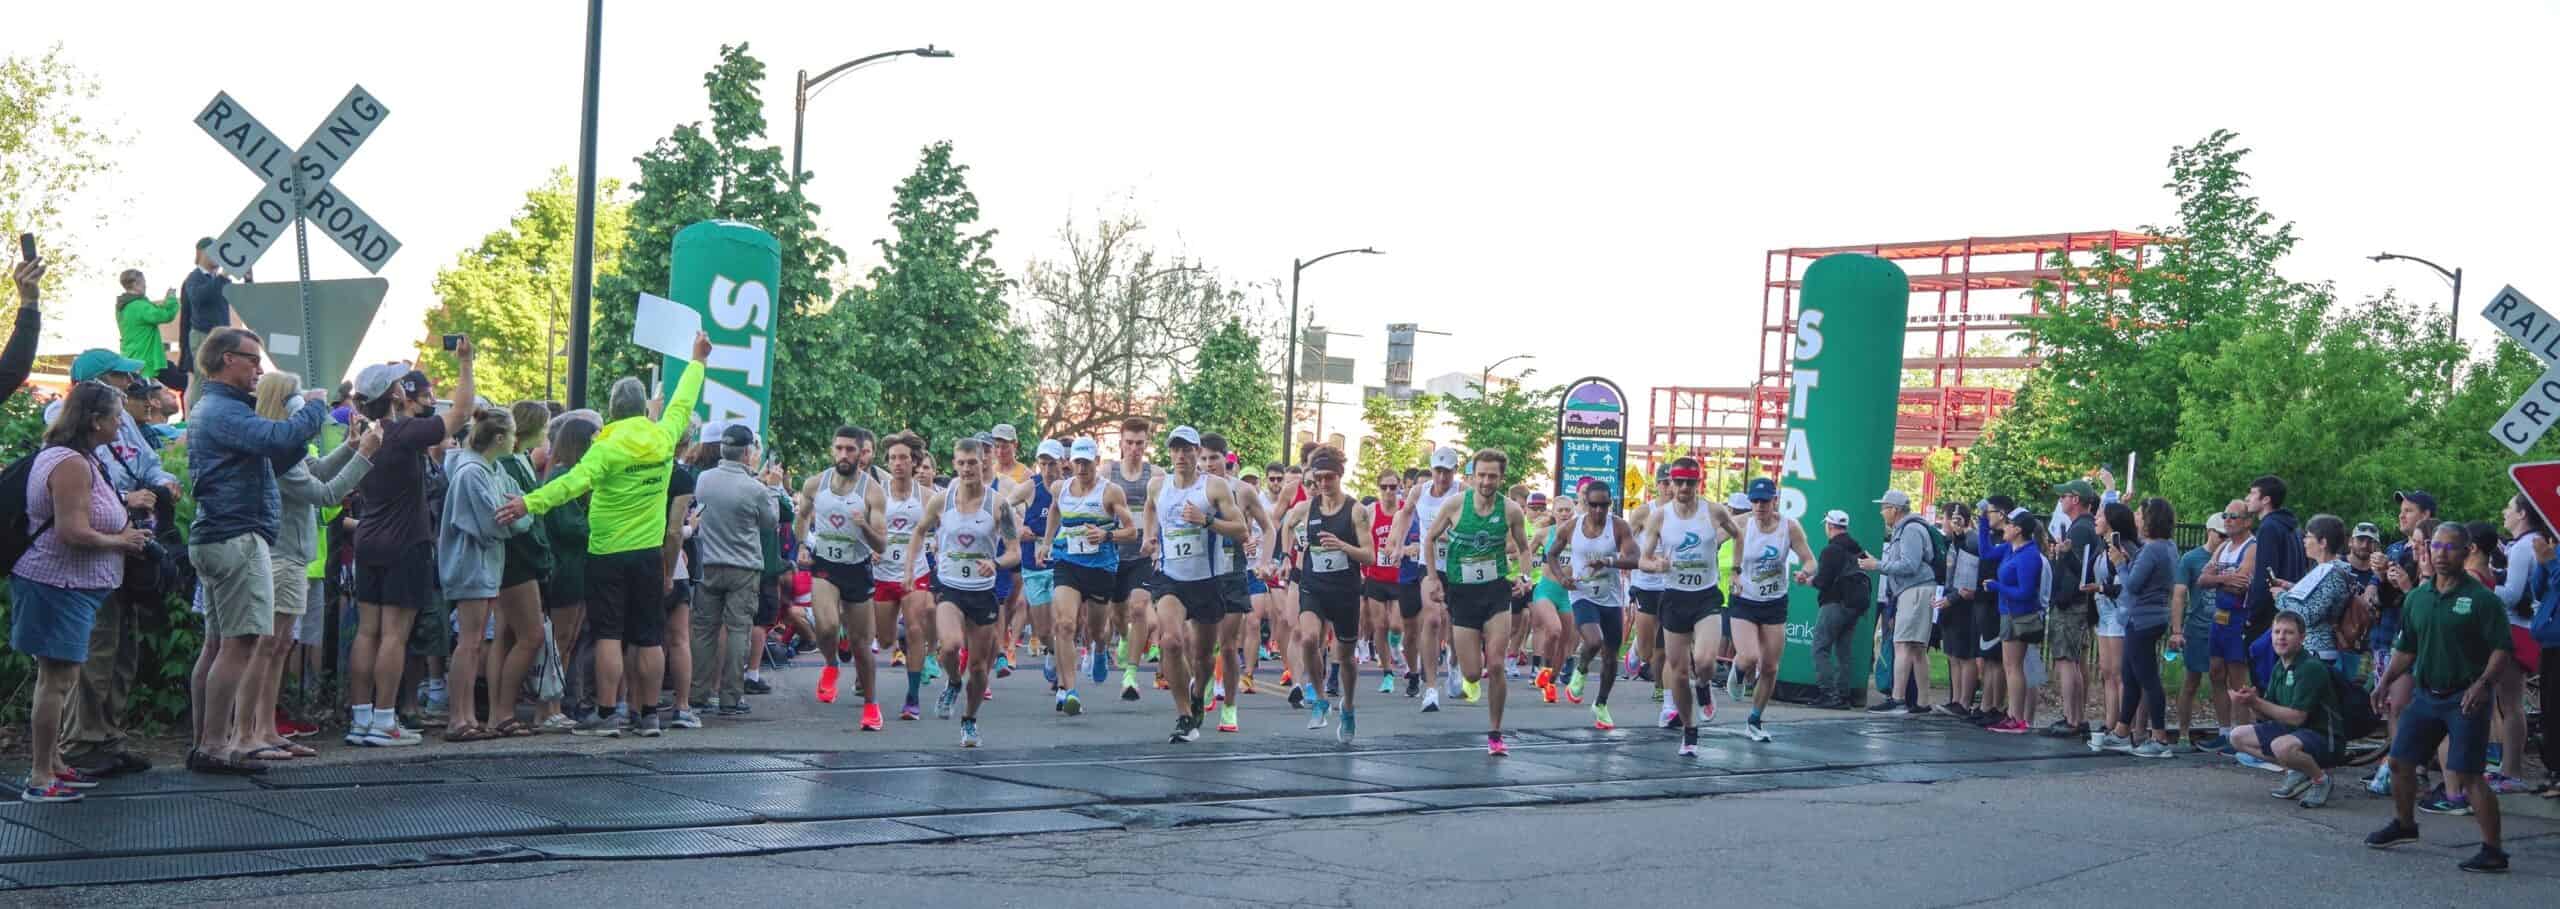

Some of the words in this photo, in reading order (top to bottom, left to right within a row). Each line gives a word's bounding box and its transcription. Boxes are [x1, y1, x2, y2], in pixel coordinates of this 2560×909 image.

[203, 99, 281, 178] RAIL
[306, 188, 389, 262] ROAD
[1567, 425, 1617, 437] Waterfront
[1567, 442, 1592, 452] Skate
[1592, 442, 1612, 453] Park
[827, 546, 843, 559] 13
[892, 549, 901, 561] 6
[1175, 542, 1192, 556] 12
[1324, 558, 1333, 570] 2
[961, 566, 971, 578] 9
[1475, 568, 1484, 580] 3
[1679, 573, 1703, 585] 270
[1592, 585, 1601, 595] 7
